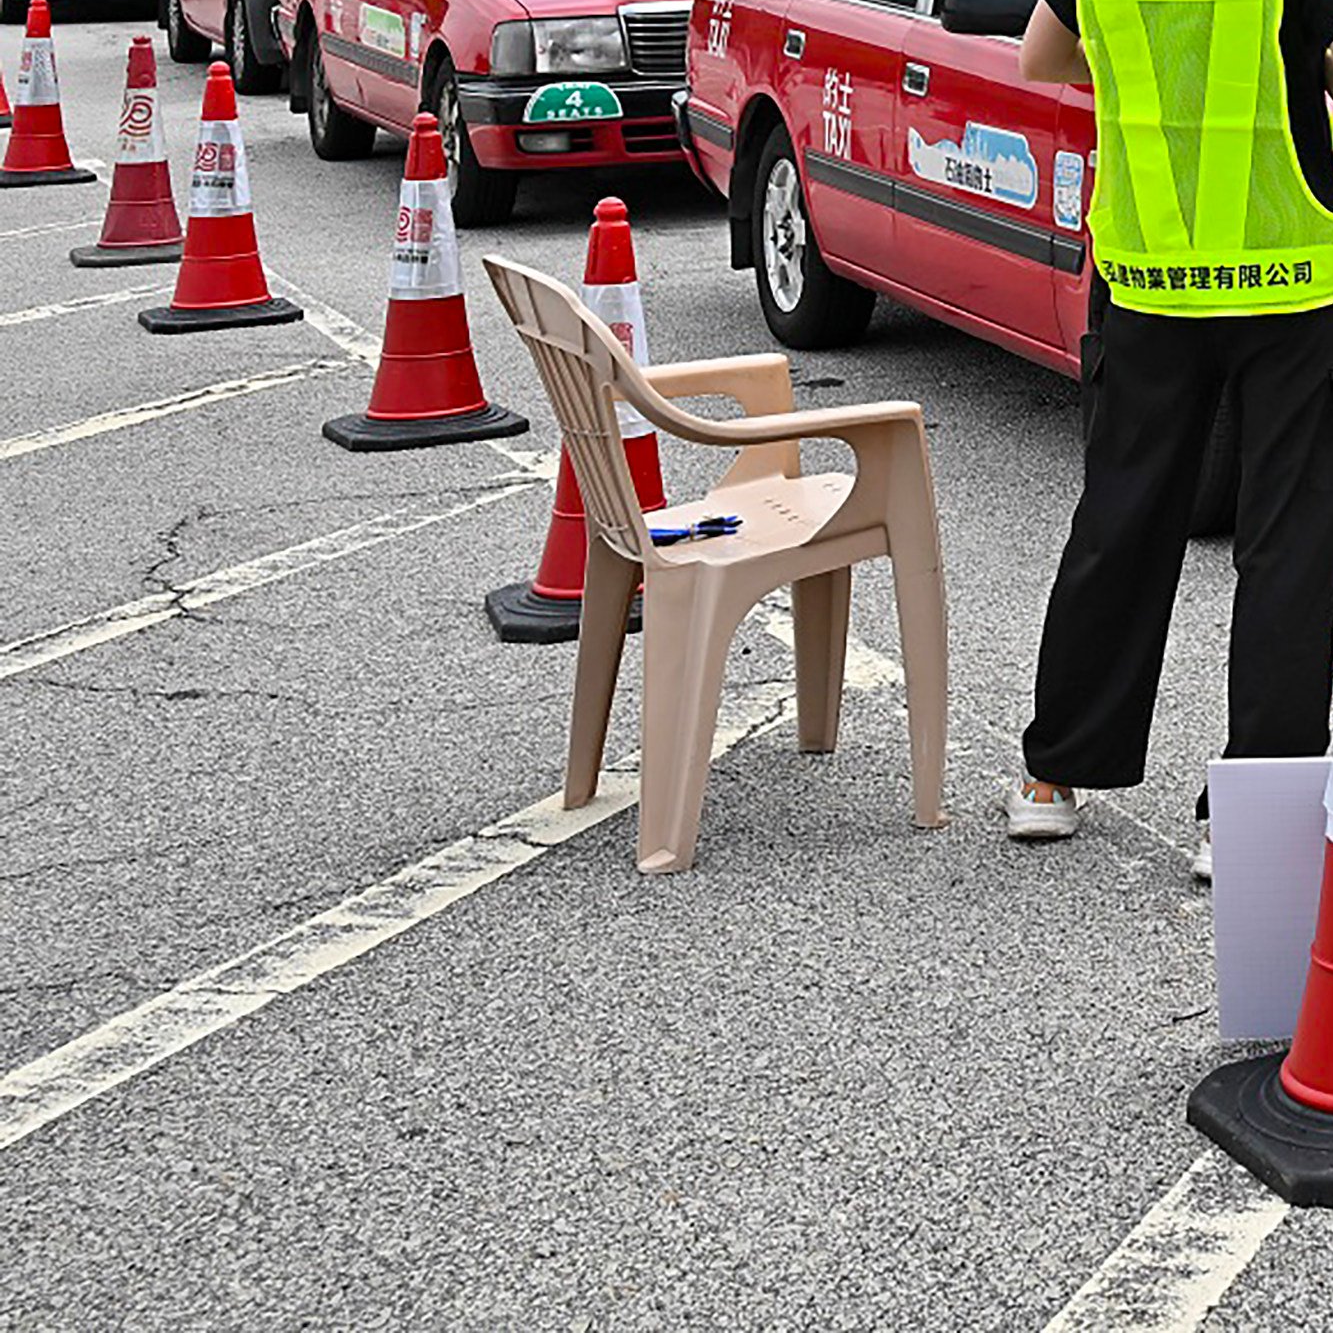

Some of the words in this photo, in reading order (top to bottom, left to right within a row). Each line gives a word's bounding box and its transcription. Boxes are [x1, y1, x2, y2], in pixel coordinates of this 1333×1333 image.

[565, 90, 584, 107] 4
[822, 67, 854, 114] 的士
[546, 107, 603, 119] SEATS
[822, 110, 852, 159] TAXI
